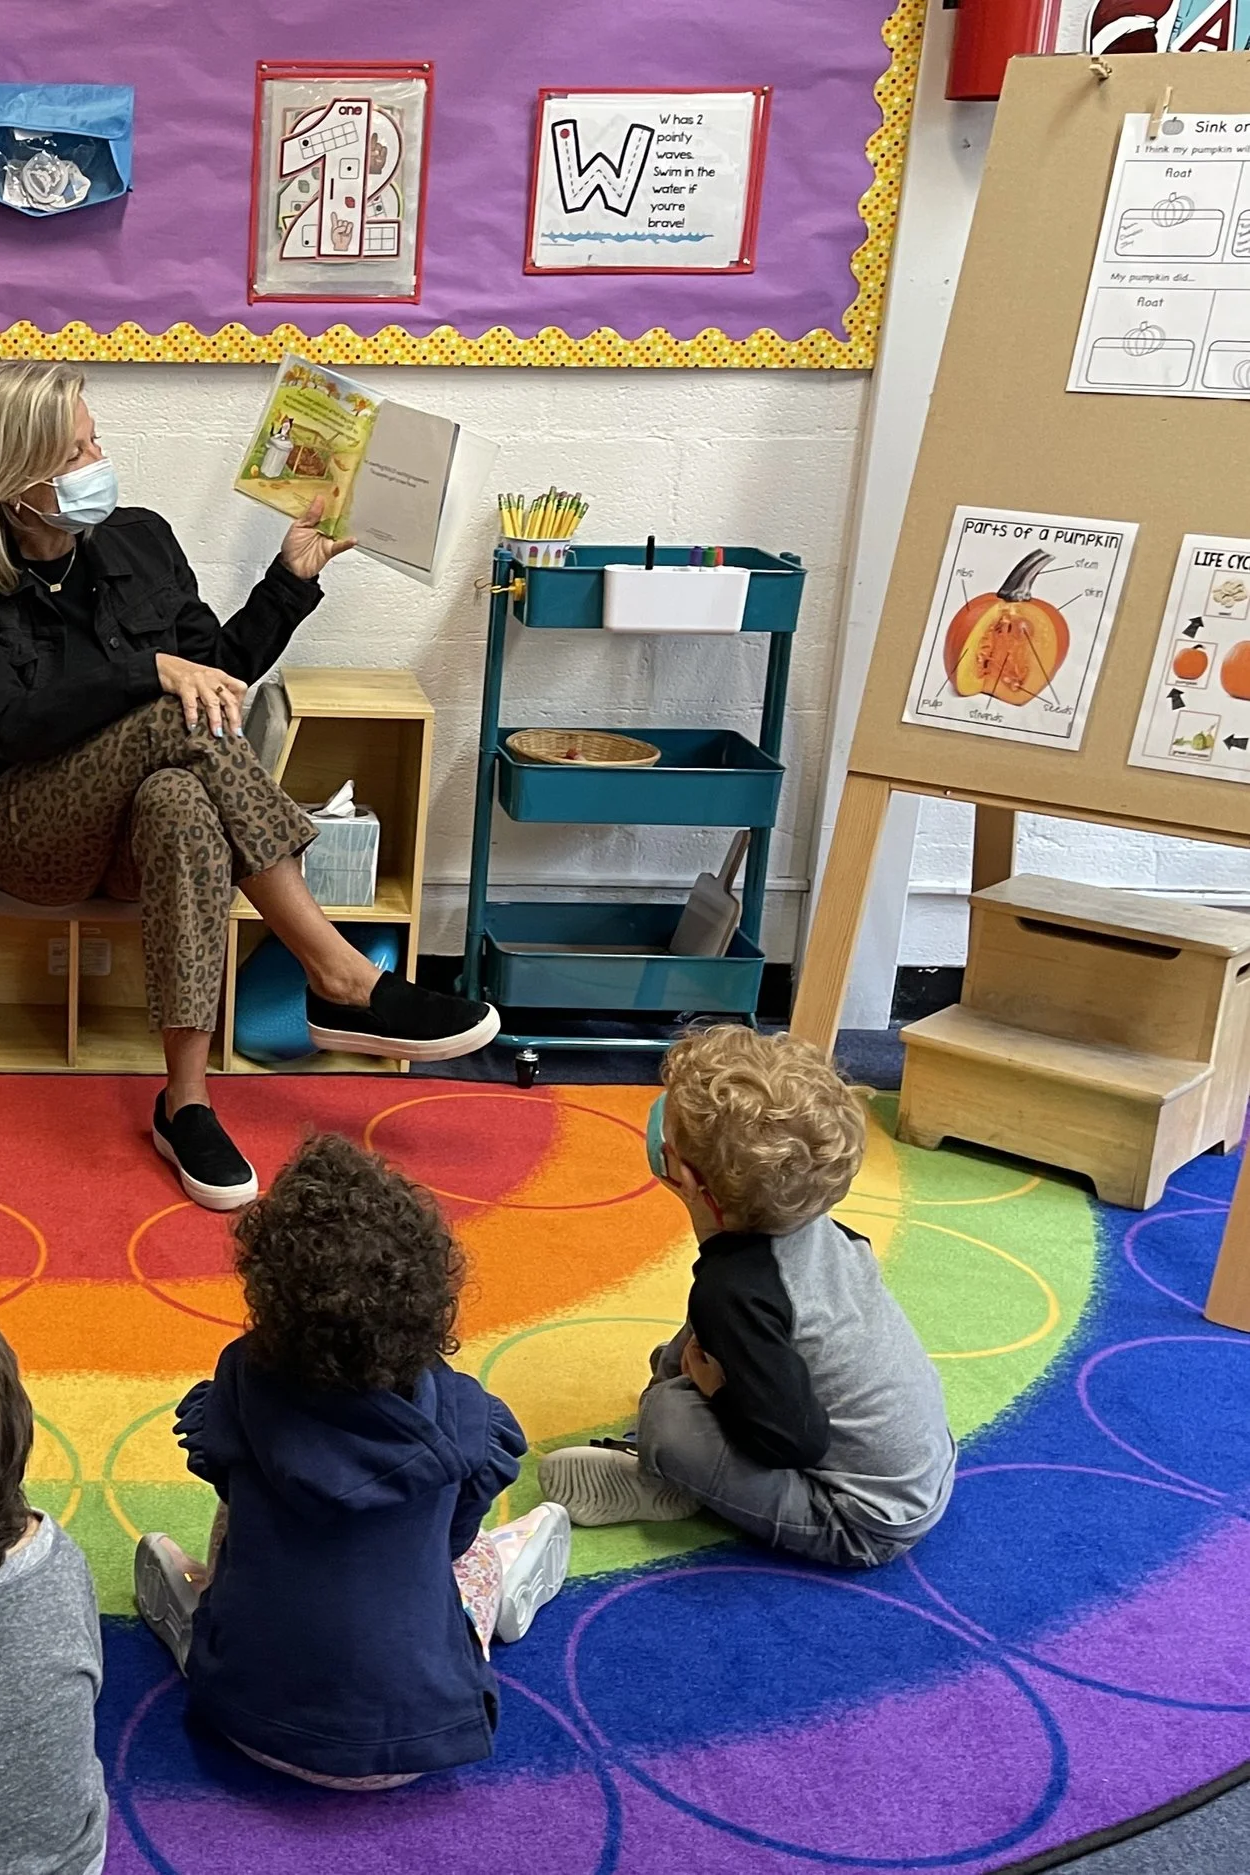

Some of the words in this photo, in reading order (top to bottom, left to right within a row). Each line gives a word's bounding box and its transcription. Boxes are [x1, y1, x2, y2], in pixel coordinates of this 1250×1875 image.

[338, 105, 363, 116] one
[659, 114, 671, 125] W
[672, 114, 694, 125] has
[696, 114, 704, 125] 2
[1195, 120, 1227, 133] Sink
[1234, 123, 1250, 133] or
[656, 132, 693, 145] pointy
[655, 151, 694, 160] waves.
[1145, 145, 1169, 153] think
[1173, 146, 1188, 156] my
[1190, 145, 1232, 156] pumpkin
[551, 118, 655, 218] W
[653, 166, 682, 177] Swim
[684, 166, 694, 177] in
[697, 166, 715, 177] the
[1165, 167, 1192, 178] float
[652, 184, 686, 194] water
[688, 183, 698, 194] if
[650, 202, 685, 213] you're
[647, 217, 685, 228] brave!
[1110, 273, 1126, 283] My
[1128, 273, 1170, 284] pumpkin
[1136, 296, 1164, 307] float
[1013, 526, 1033, 540] of
[1074, 558, 1099, 570] stem
[1194, 551, 1225, 568] LIFE
[955, 567, 974, 578] ribs
[1084, 588, 1103, 598] skin
[1043, 703, 1073, 716] seeds
[969, 709, 1004, 723] strands
